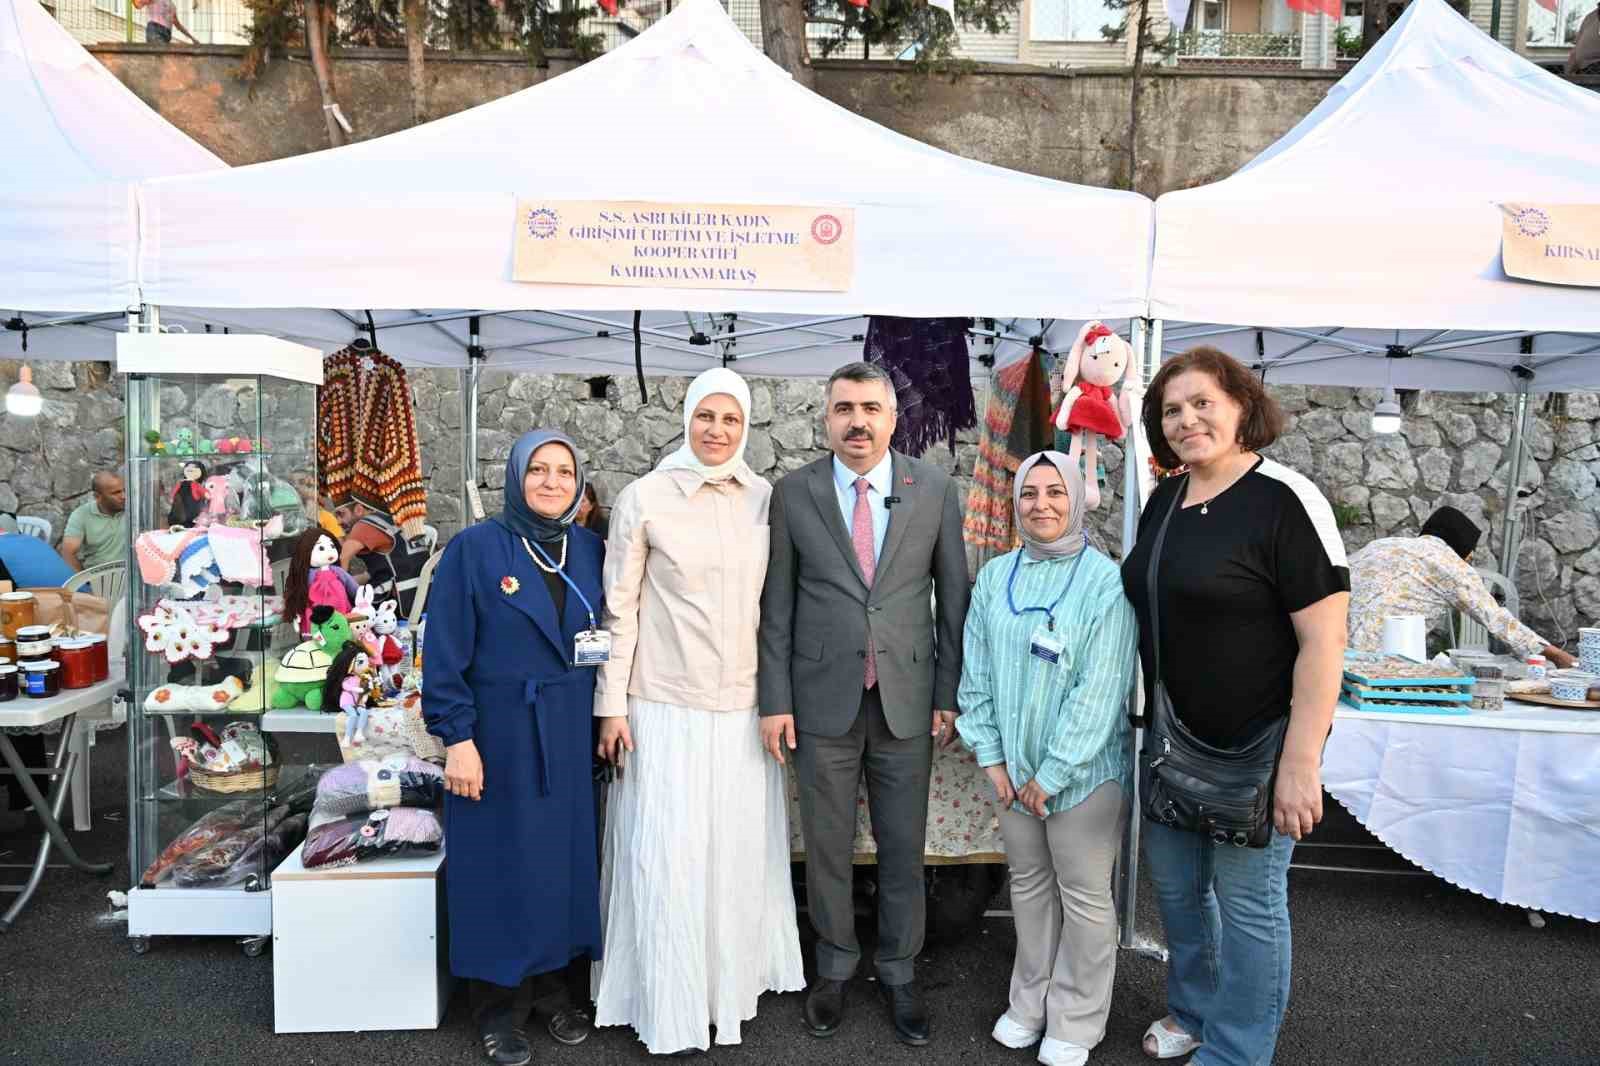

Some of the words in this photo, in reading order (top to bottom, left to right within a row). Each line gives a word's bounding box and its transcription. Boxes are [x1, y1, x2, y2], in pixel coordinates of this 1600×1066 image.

[599, 211, 626, 224] S.S.
[670, 209, 717, 226] KİLER
[721, 213, 772, 227] KADIN
[569, 225, 636, 243] GİRİŞİMİ
[641, 226, 701, 242] ÜRETİM
[705, 230, 727, 242] VE
[729, 229, 800, 246] İŞLETME
[633, 245, 737, 260] KOOPERATİFİ
[610, 264, 757, 283] KAHRAMANMARAŞ
